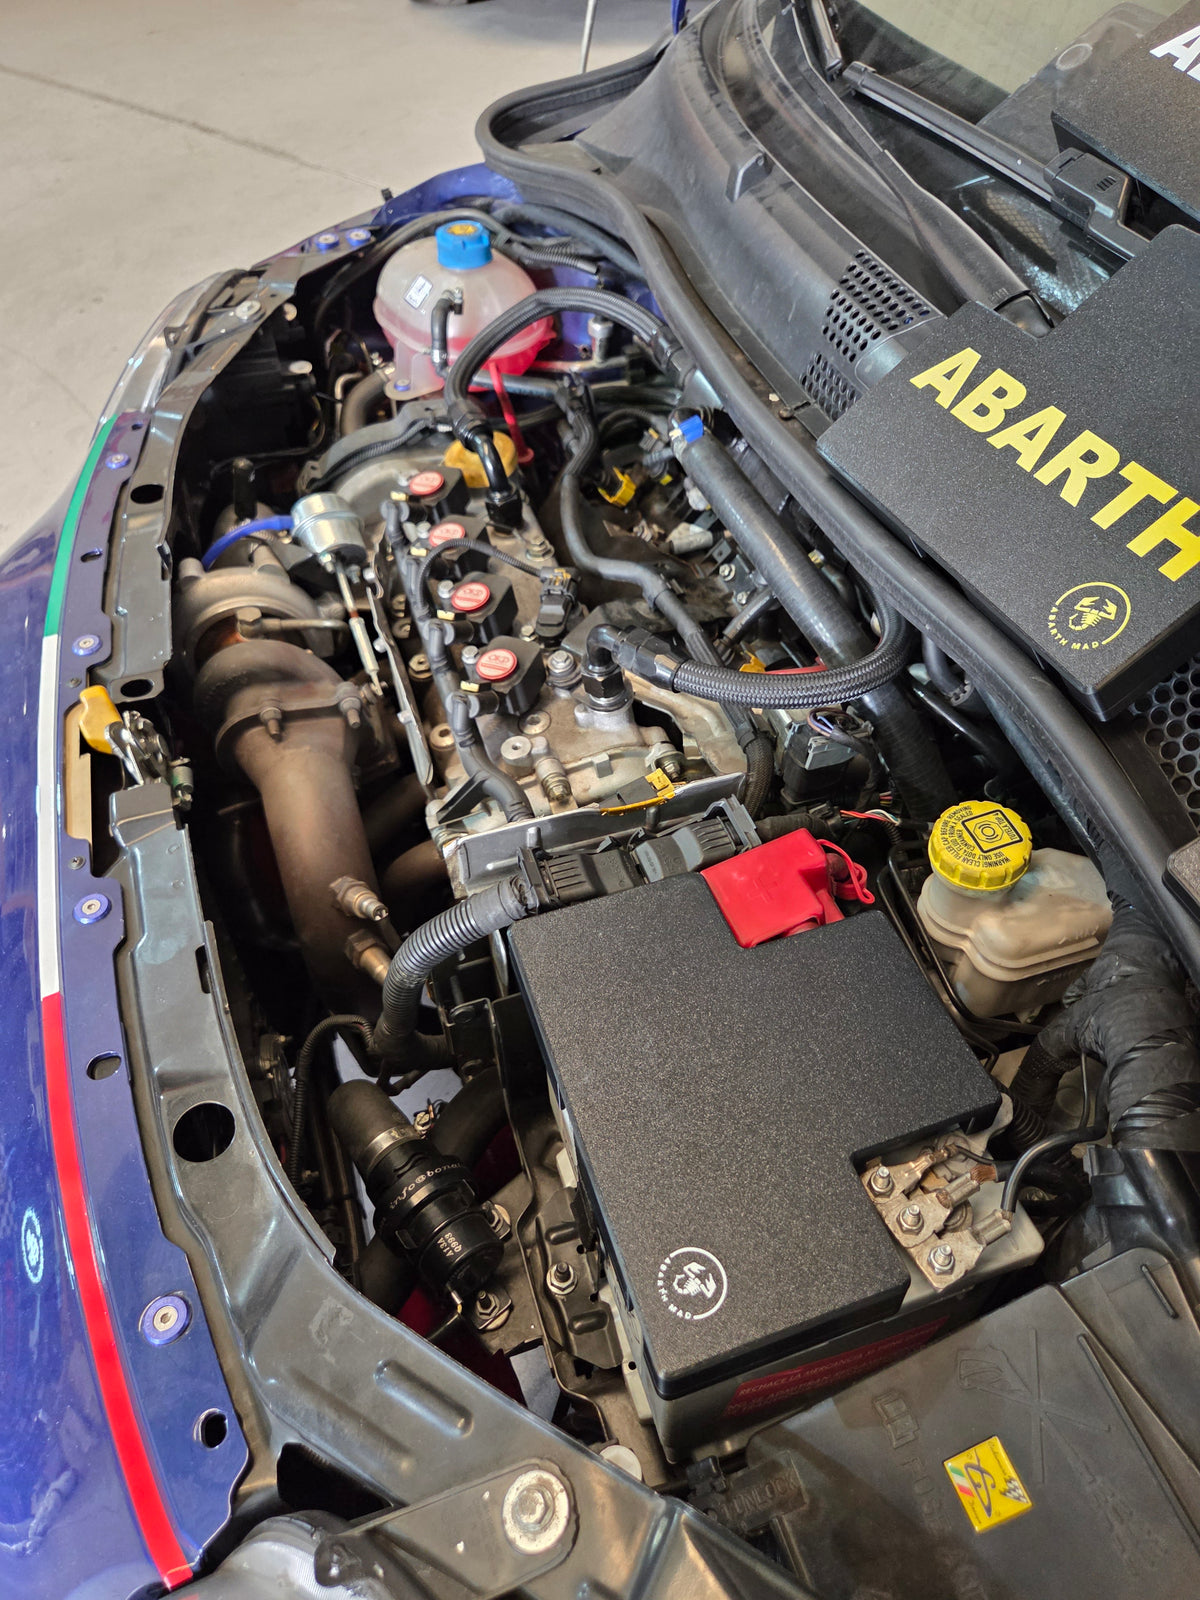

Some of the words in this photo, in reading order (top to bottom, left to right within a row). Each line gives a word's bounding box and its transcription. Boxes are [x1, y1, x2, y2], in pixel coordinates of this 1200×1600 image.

[1149, 25, 1200, 82] A
[909, 347, 1200, 582] ABARTH
[1047, 606, 1068, 646] ABARTH
[1070, 641, 1099, 650] MAD
[940, 836, 950, 846] CAP
[961, 857, 980, 867] CLEAN
[993, 850, 1005, 860] USE
[437, 1237, 455, 1257] A13A
[444, 1232, 462, 1253] Q993
[657, 1257, 671, 1302] ABARTH
[668, 1303, 692, 1320] MAD
